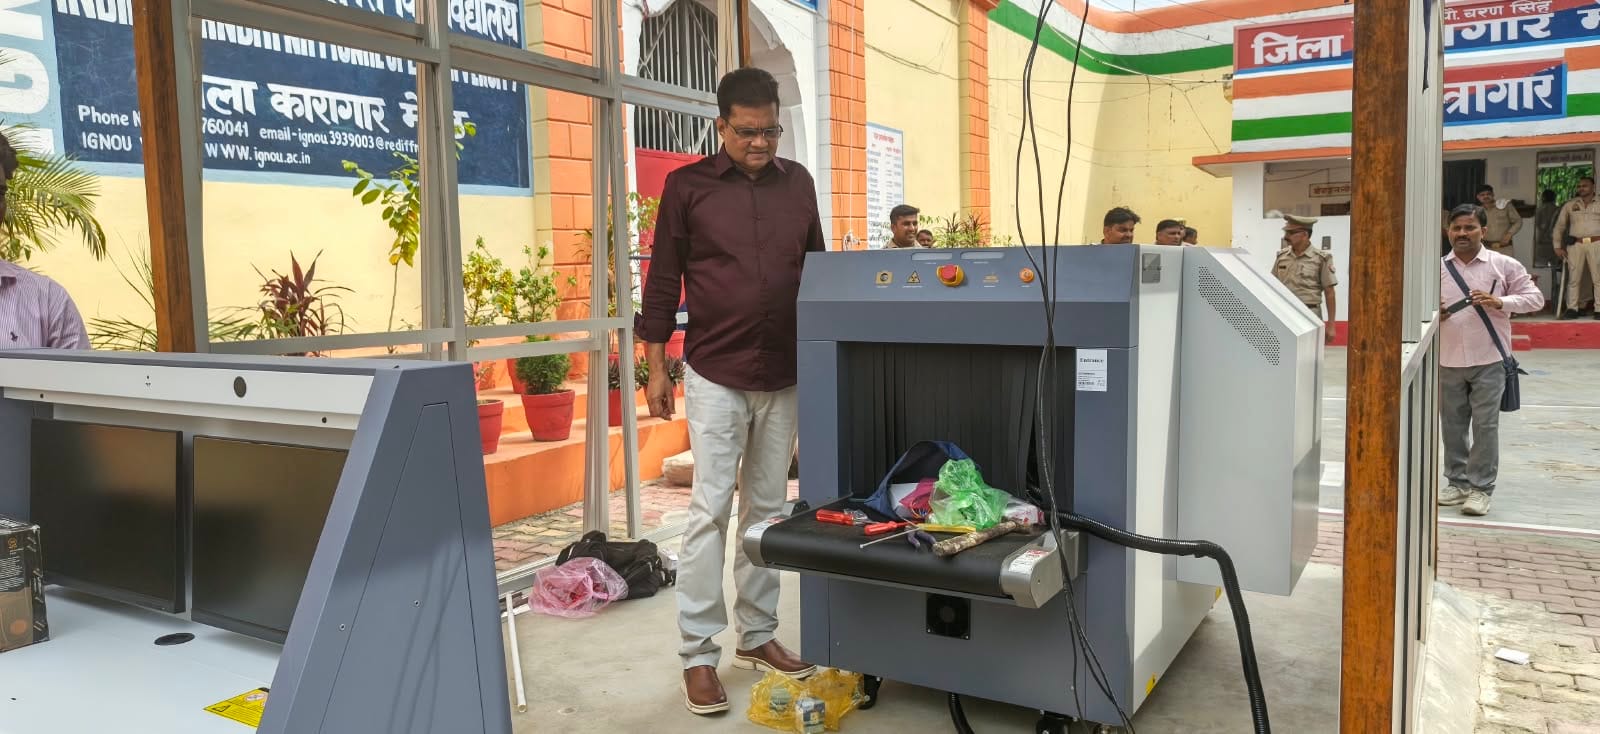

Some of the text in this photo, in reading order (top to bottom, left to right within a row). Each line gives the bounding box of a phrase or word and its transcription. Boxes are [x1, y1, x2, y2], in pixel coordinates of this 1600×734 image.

[1251, 31, 1345, 65] जिला
[267, 83, 389, 133] कारागार
[1443, 74, 1555, 115] त्रागार
[78, 104, 130, 127] Phone
[202, 117, 249, 138] 760041
[82, 131, 132, 151] IGNOU
